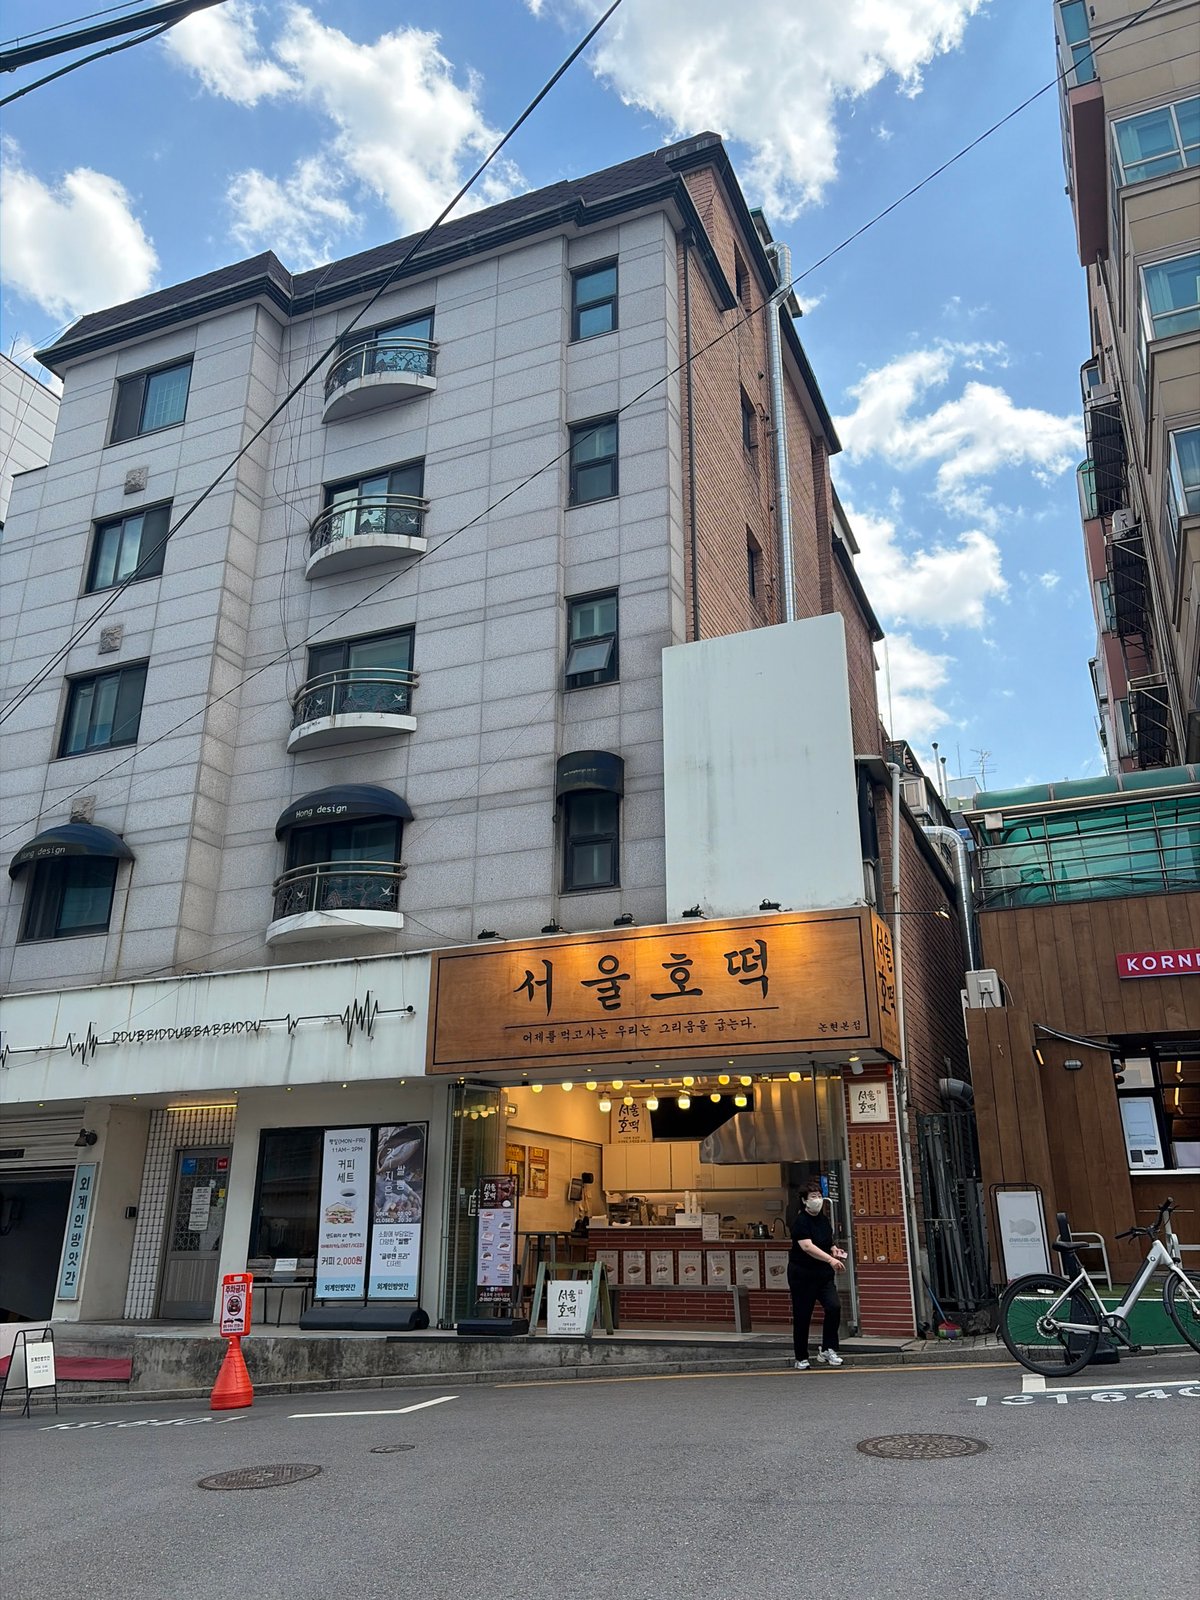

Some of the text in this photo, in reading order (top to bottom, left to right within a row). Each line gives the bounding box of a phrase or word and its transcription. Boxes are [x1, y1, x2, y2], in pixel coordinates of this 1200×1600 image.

[295, 803, 347, 820] Hong design
[37, 845, 66, 857] design
[513, 939, 769, 1016] 서울호떡
[615, 1023, 651, 1038] 우리는
[659, 1019, 708, 1034] 그리움을
[714, 1015, 757, 1031] 굽는다.
[818, 1019, 861, 1033] 논현본점
[858, 1090, 876, 1102] 서울
[618, 1103, 640, 1118] 서울
[858, 1101, 877, 1114] 호떡
[618, 1116, 640, 1134] 호떡
[337, 1158, 355, 1171] 커피
[336, 1171, 355, 1184] 세트
[64, 1176, 91, 1287] 외계인방앗간
[321, 1255, 363, 1267] 커피 2,000원
[225, 1284, 246, 1294] 주차금지
[324, 1283, 356, 1292] 외계인방앗간
[376, 1282, 409, 1291] 외계인방앗간
[557, 1289, 577, 1303] 서울
[557, 1302, 577, 1318] 호떡
